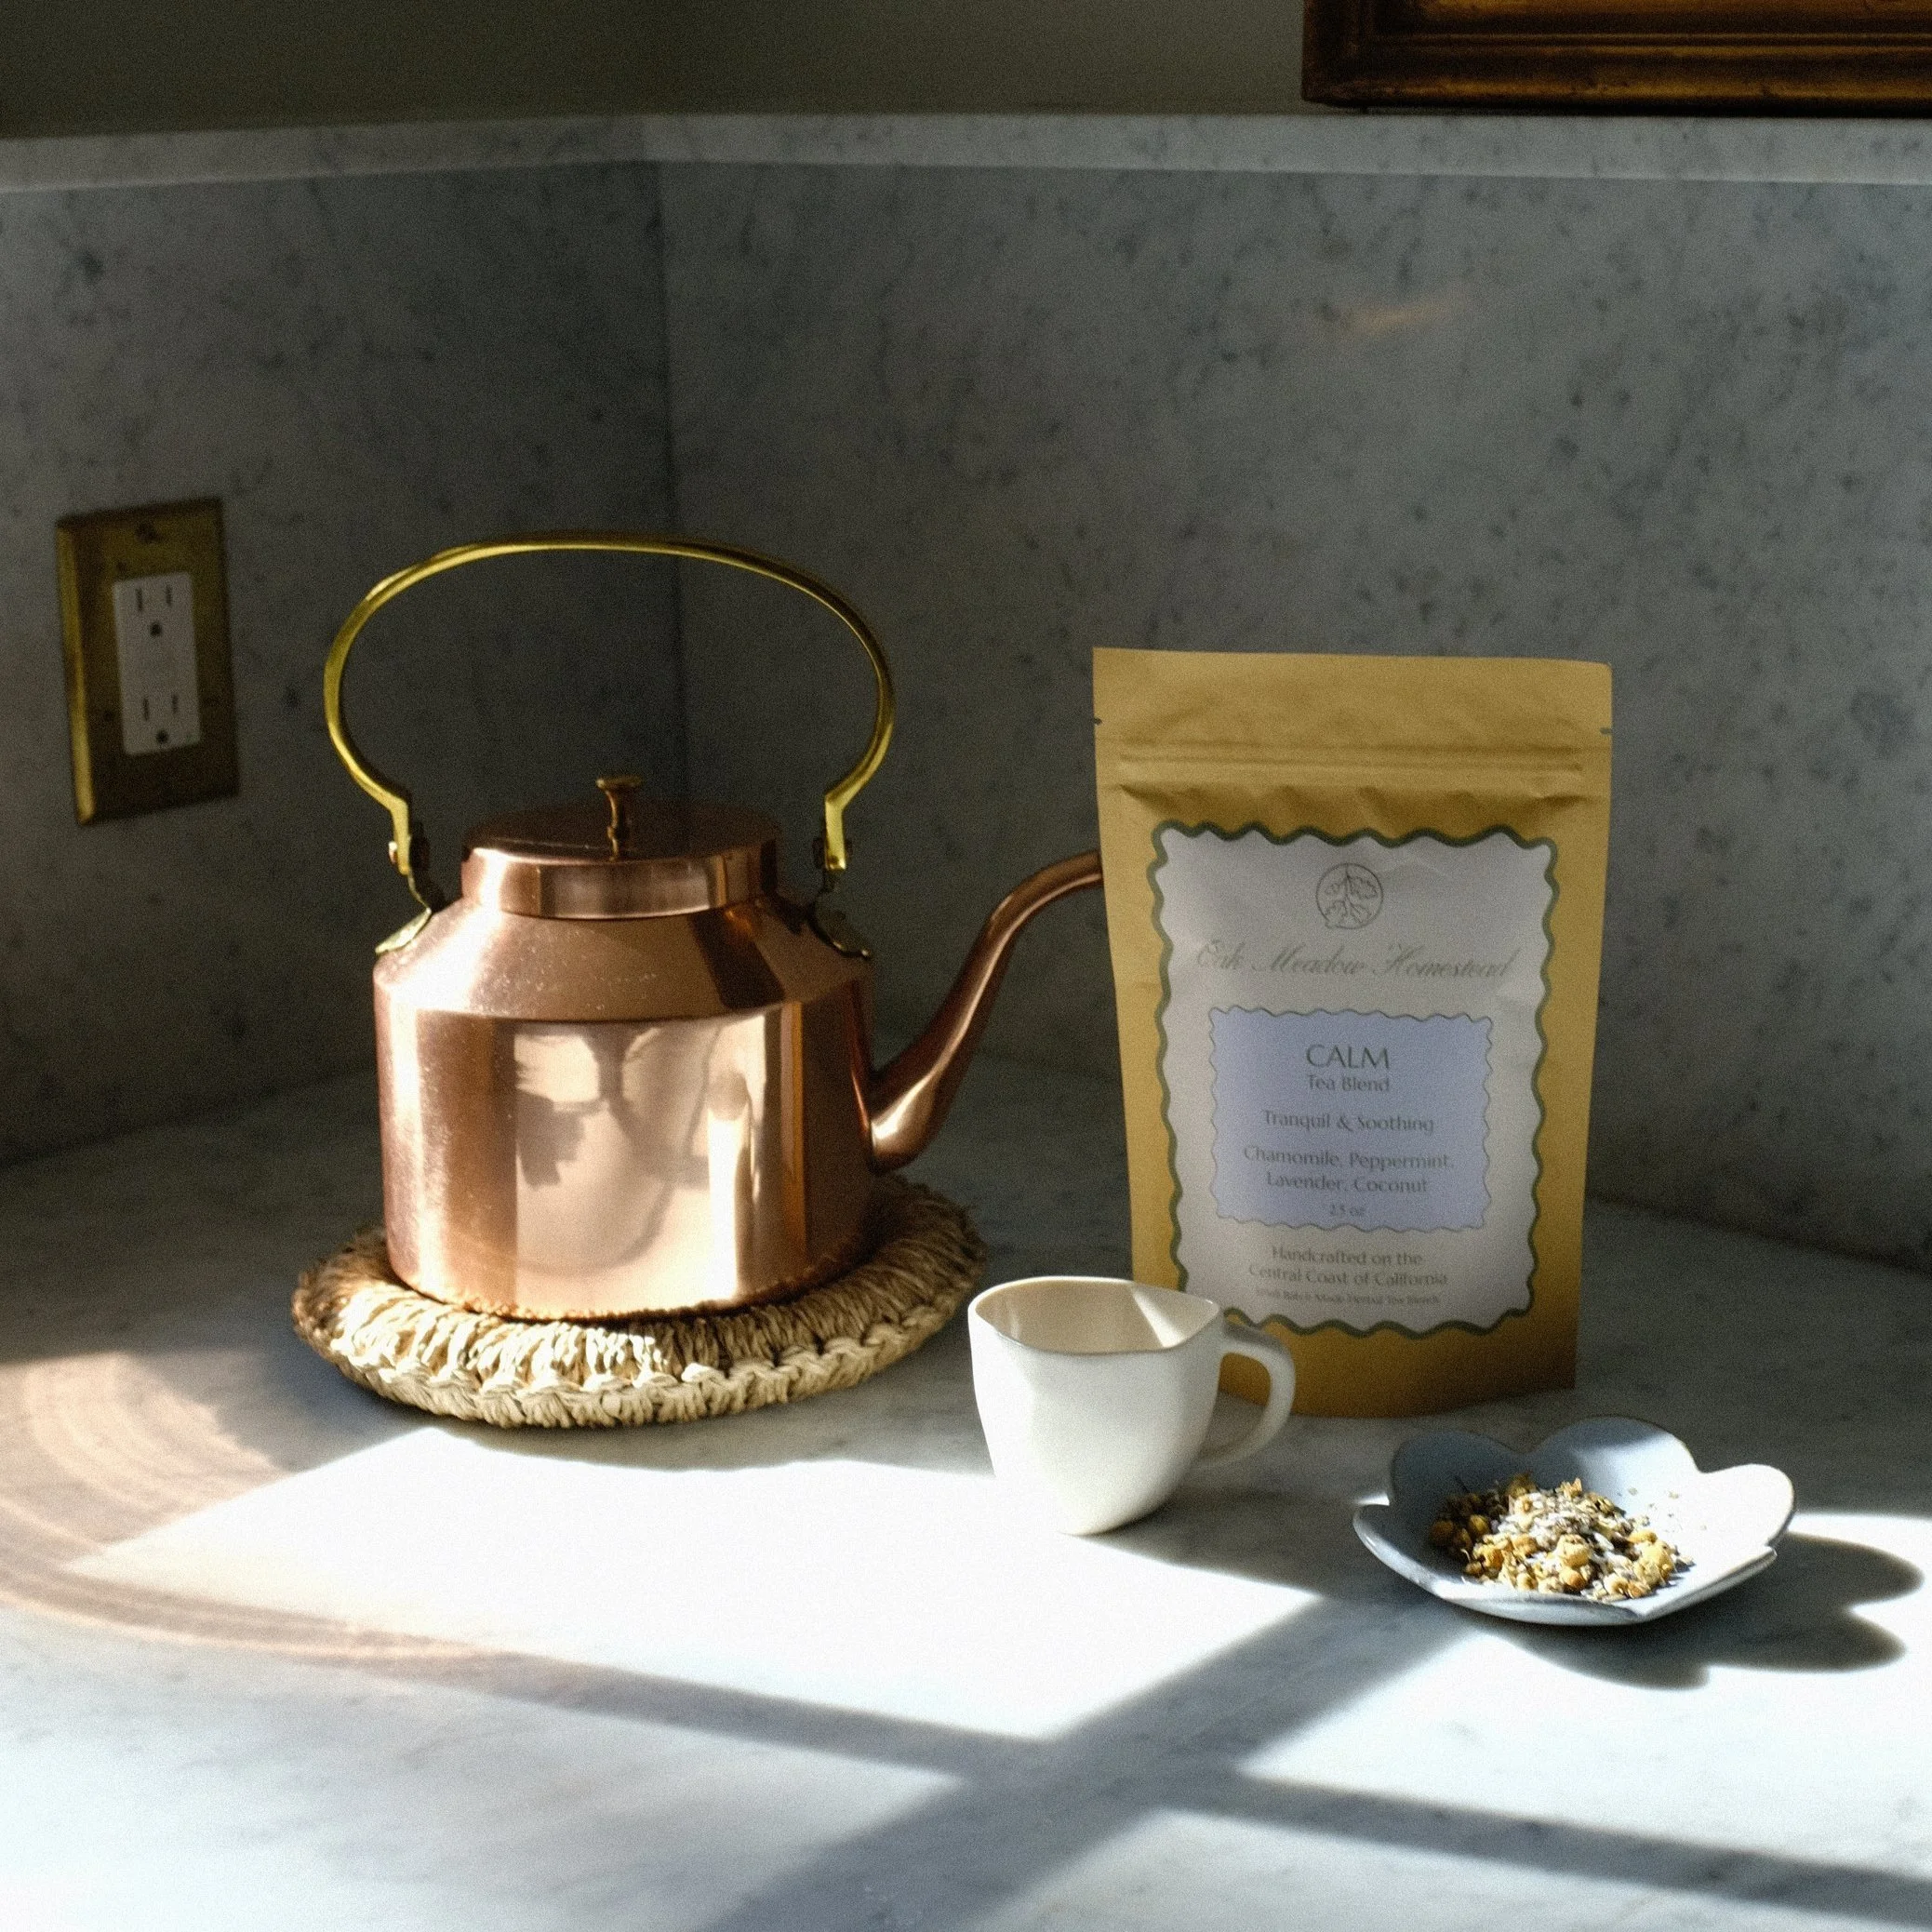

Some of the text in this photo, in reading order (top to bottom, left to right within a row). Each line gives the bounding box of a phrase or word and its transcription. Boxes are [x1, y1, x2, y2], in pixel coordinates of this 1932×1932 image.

[1196, 939, 1521, 978] Oak Meadow Homestead
[1305, 1043, 1390, 1070] CALM
[1308, 1074, 1390, 1092] Tea Blend
[1263, 1110, 1434, 1135] Tranquil & Soothing
[1353, 1176, 1428, 1193] Coconut
[1272, 1245, 1422, 1266] Handcrafted on the
[1248, 1265, 1447, 1287] Central Coast of California
